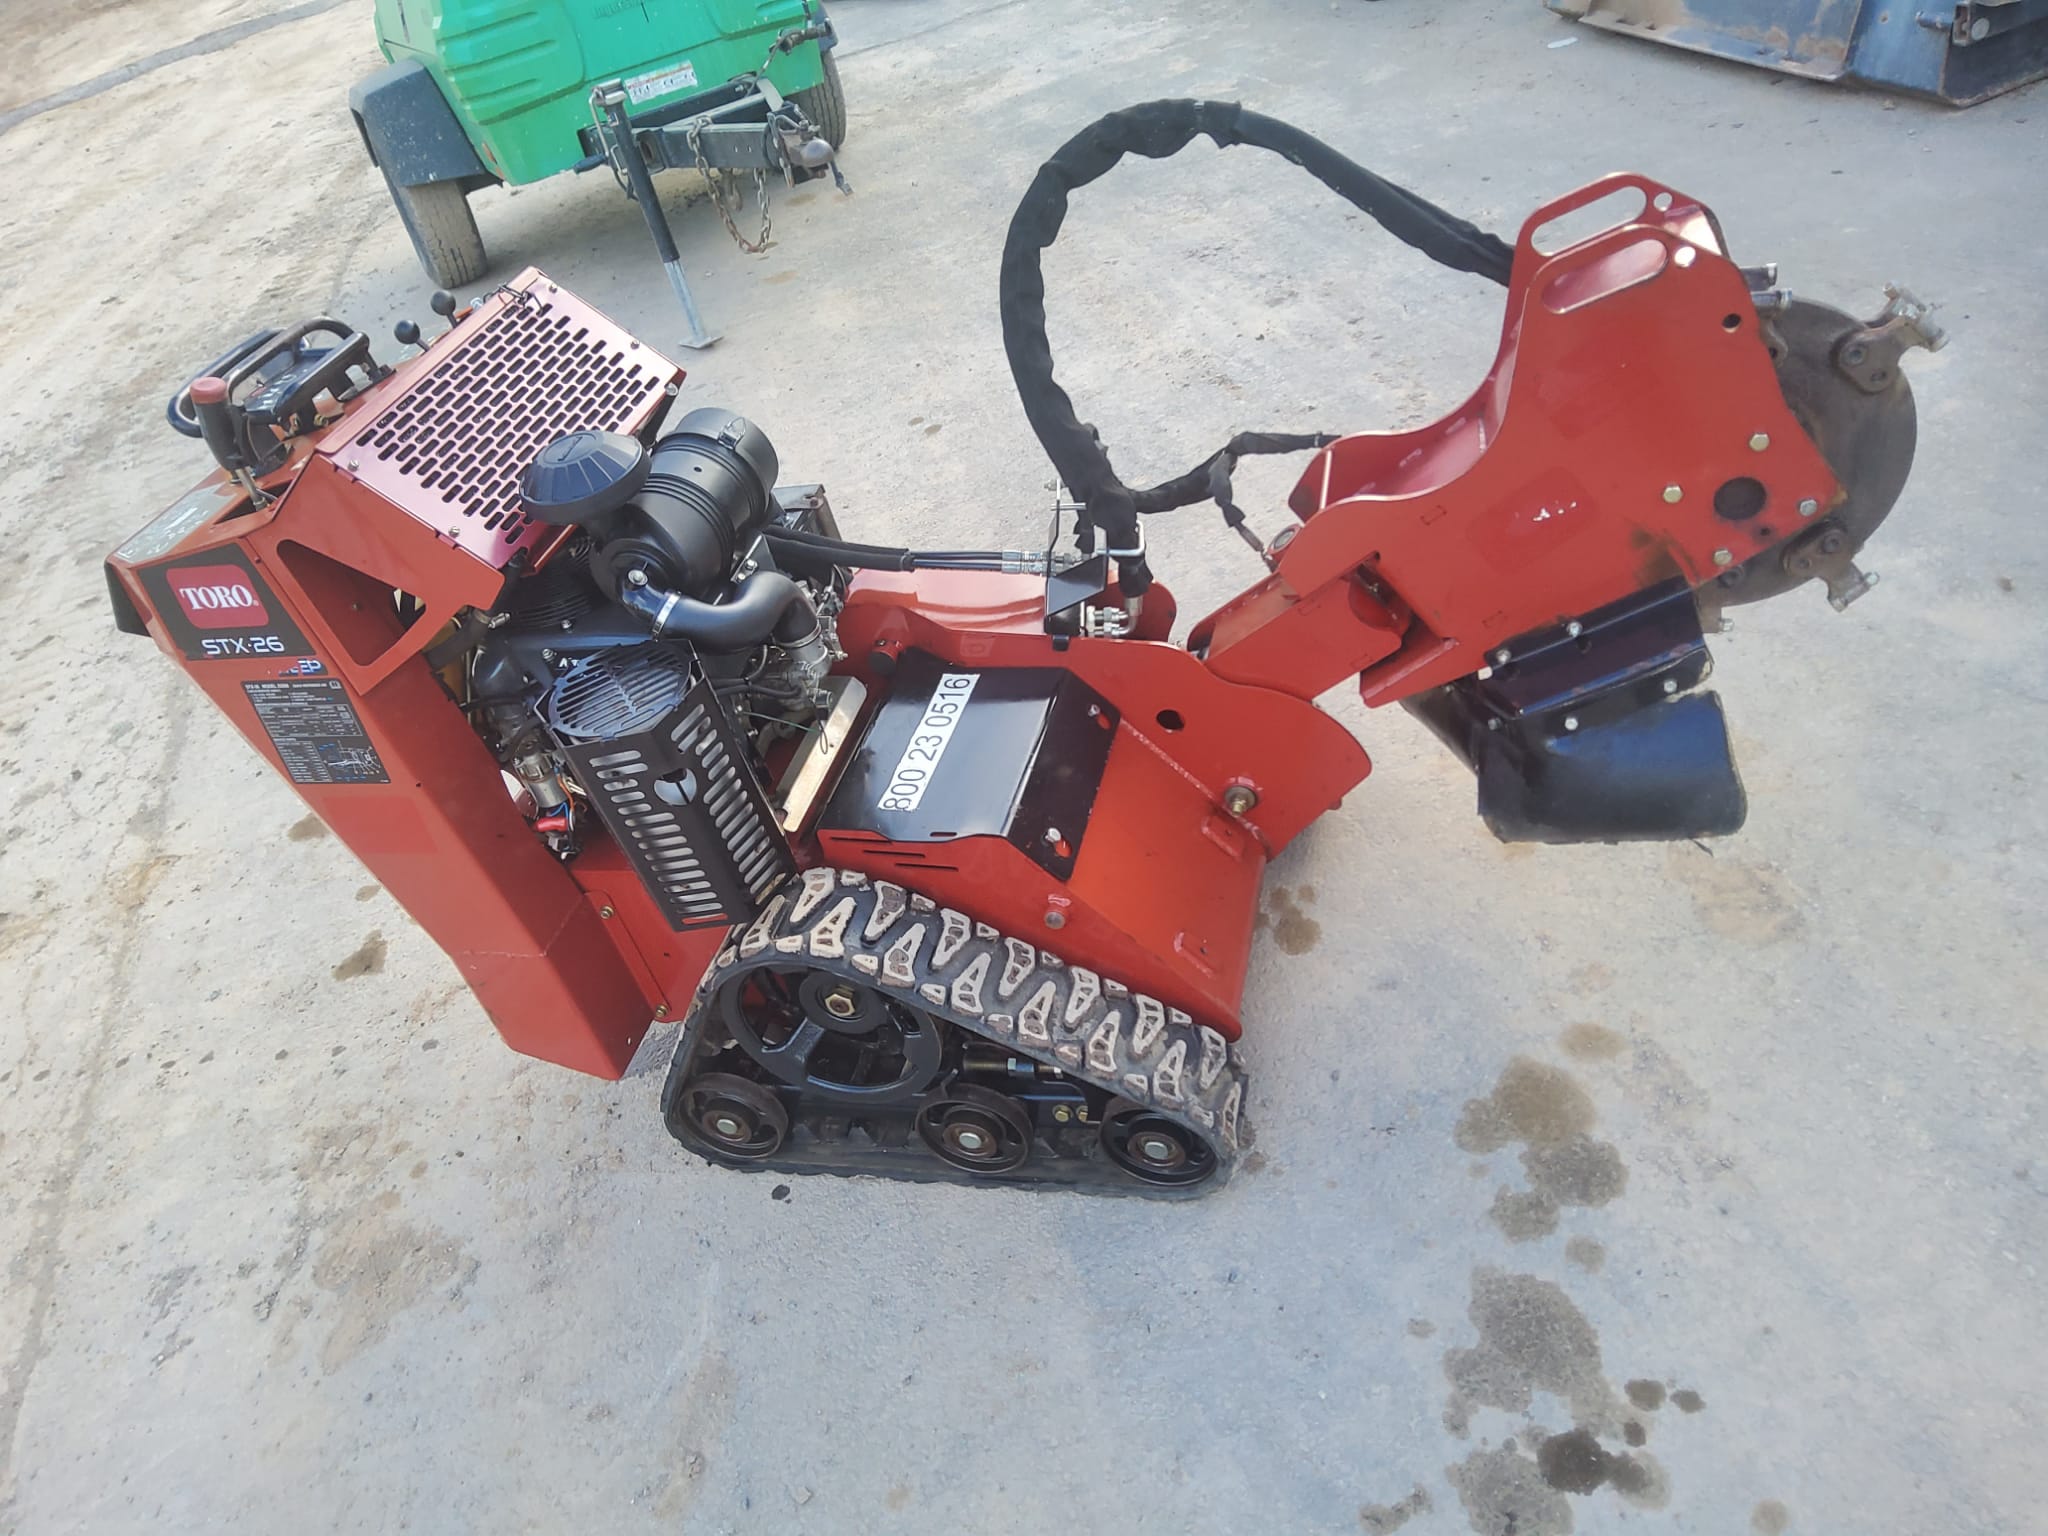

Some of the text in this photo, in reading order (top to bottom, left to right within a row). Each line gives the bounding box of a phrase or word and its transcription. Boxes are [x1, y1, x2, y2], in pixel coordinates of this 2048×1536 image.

[179, 584, 254, 610] TORO
[883, 678, 970, 812] 800 23 0516
